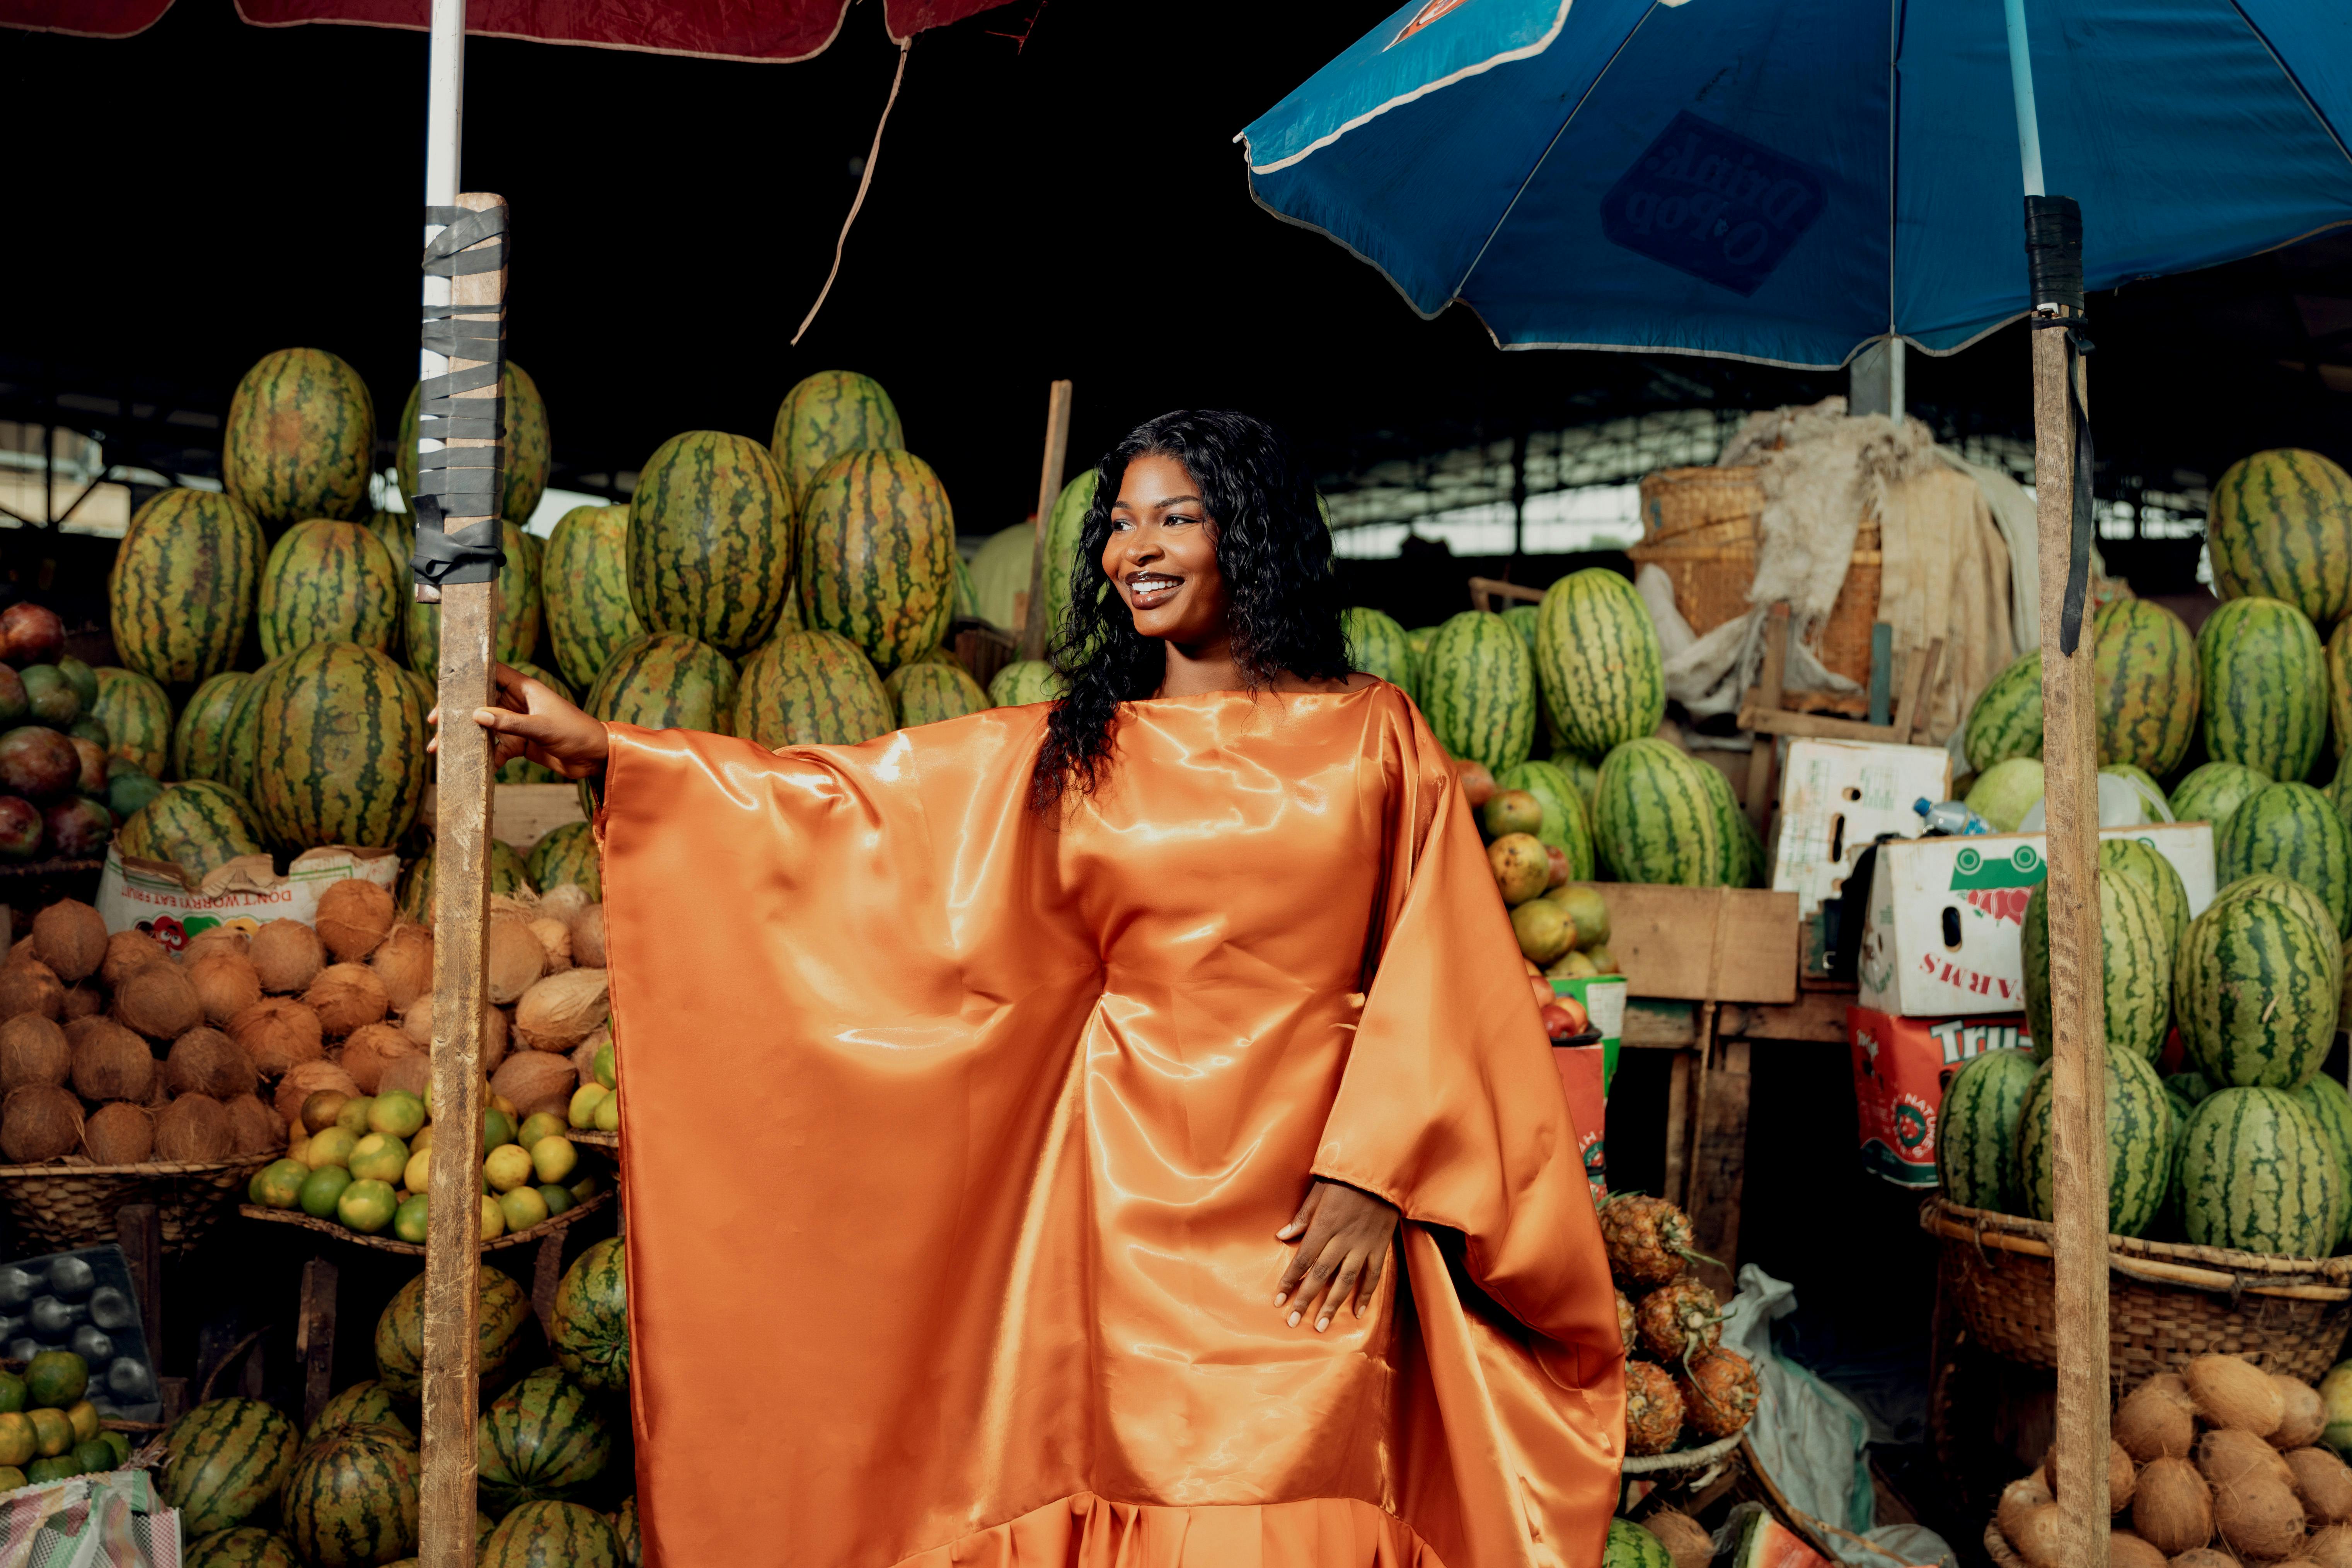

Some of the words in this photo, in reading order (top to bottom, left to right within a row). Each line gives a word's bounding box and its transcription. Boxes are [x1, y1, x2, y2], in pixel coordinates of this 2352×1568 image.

[154, 895, 177, 907] EAT
[179, 895, 239, 910] WORRY!
[243, 890, 291, 906] DON'T
[1917, 952, 2023, 1002] ARMS
